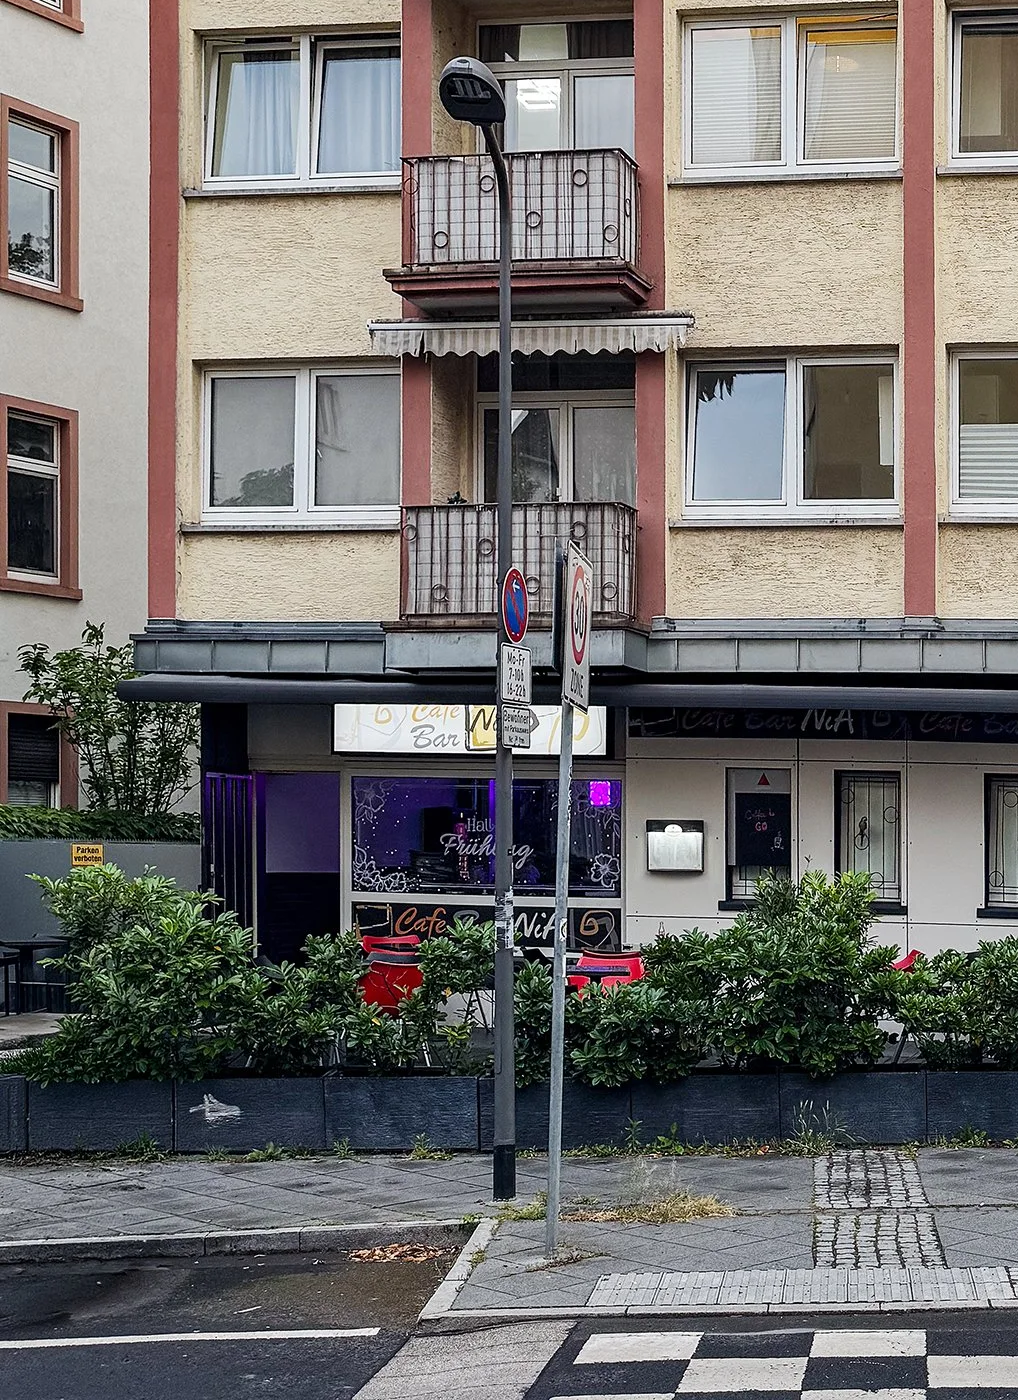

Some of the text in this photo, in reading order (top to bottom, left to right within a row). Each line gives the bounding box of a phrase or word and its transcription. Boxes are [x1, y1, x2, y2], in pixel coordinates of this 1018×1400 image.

[574, 591, 585, 640] 30
[507, 651, 526, 667] Mo-Fr
[570, 668, 584, 698] ZONE
[410, 724, 461, 749] Bar
[77, 846, 100, 854] Parken
[394, 906, 448, 939] Cafe
